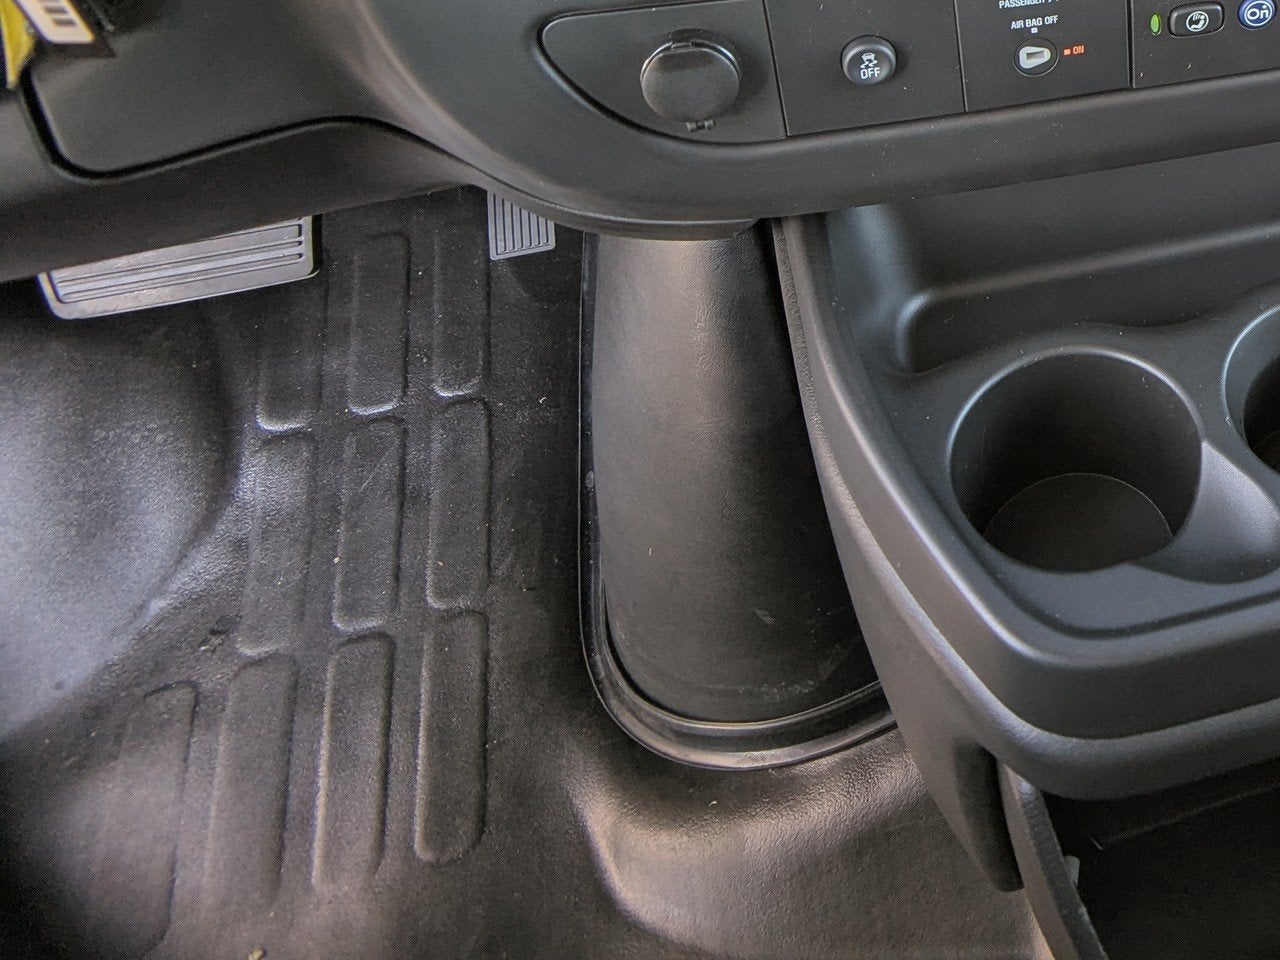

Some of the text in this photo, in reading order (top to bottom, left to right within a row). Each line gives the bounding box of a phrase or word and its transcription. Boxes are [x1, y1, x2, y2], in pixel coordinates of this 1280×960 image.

[1246, 5, 1270, 19] On
[1011, 14, 1059, 29] AIR BAG OFF
[1072, 45, 1085, 54] ON
[860, 67, 881, 79] OFF
